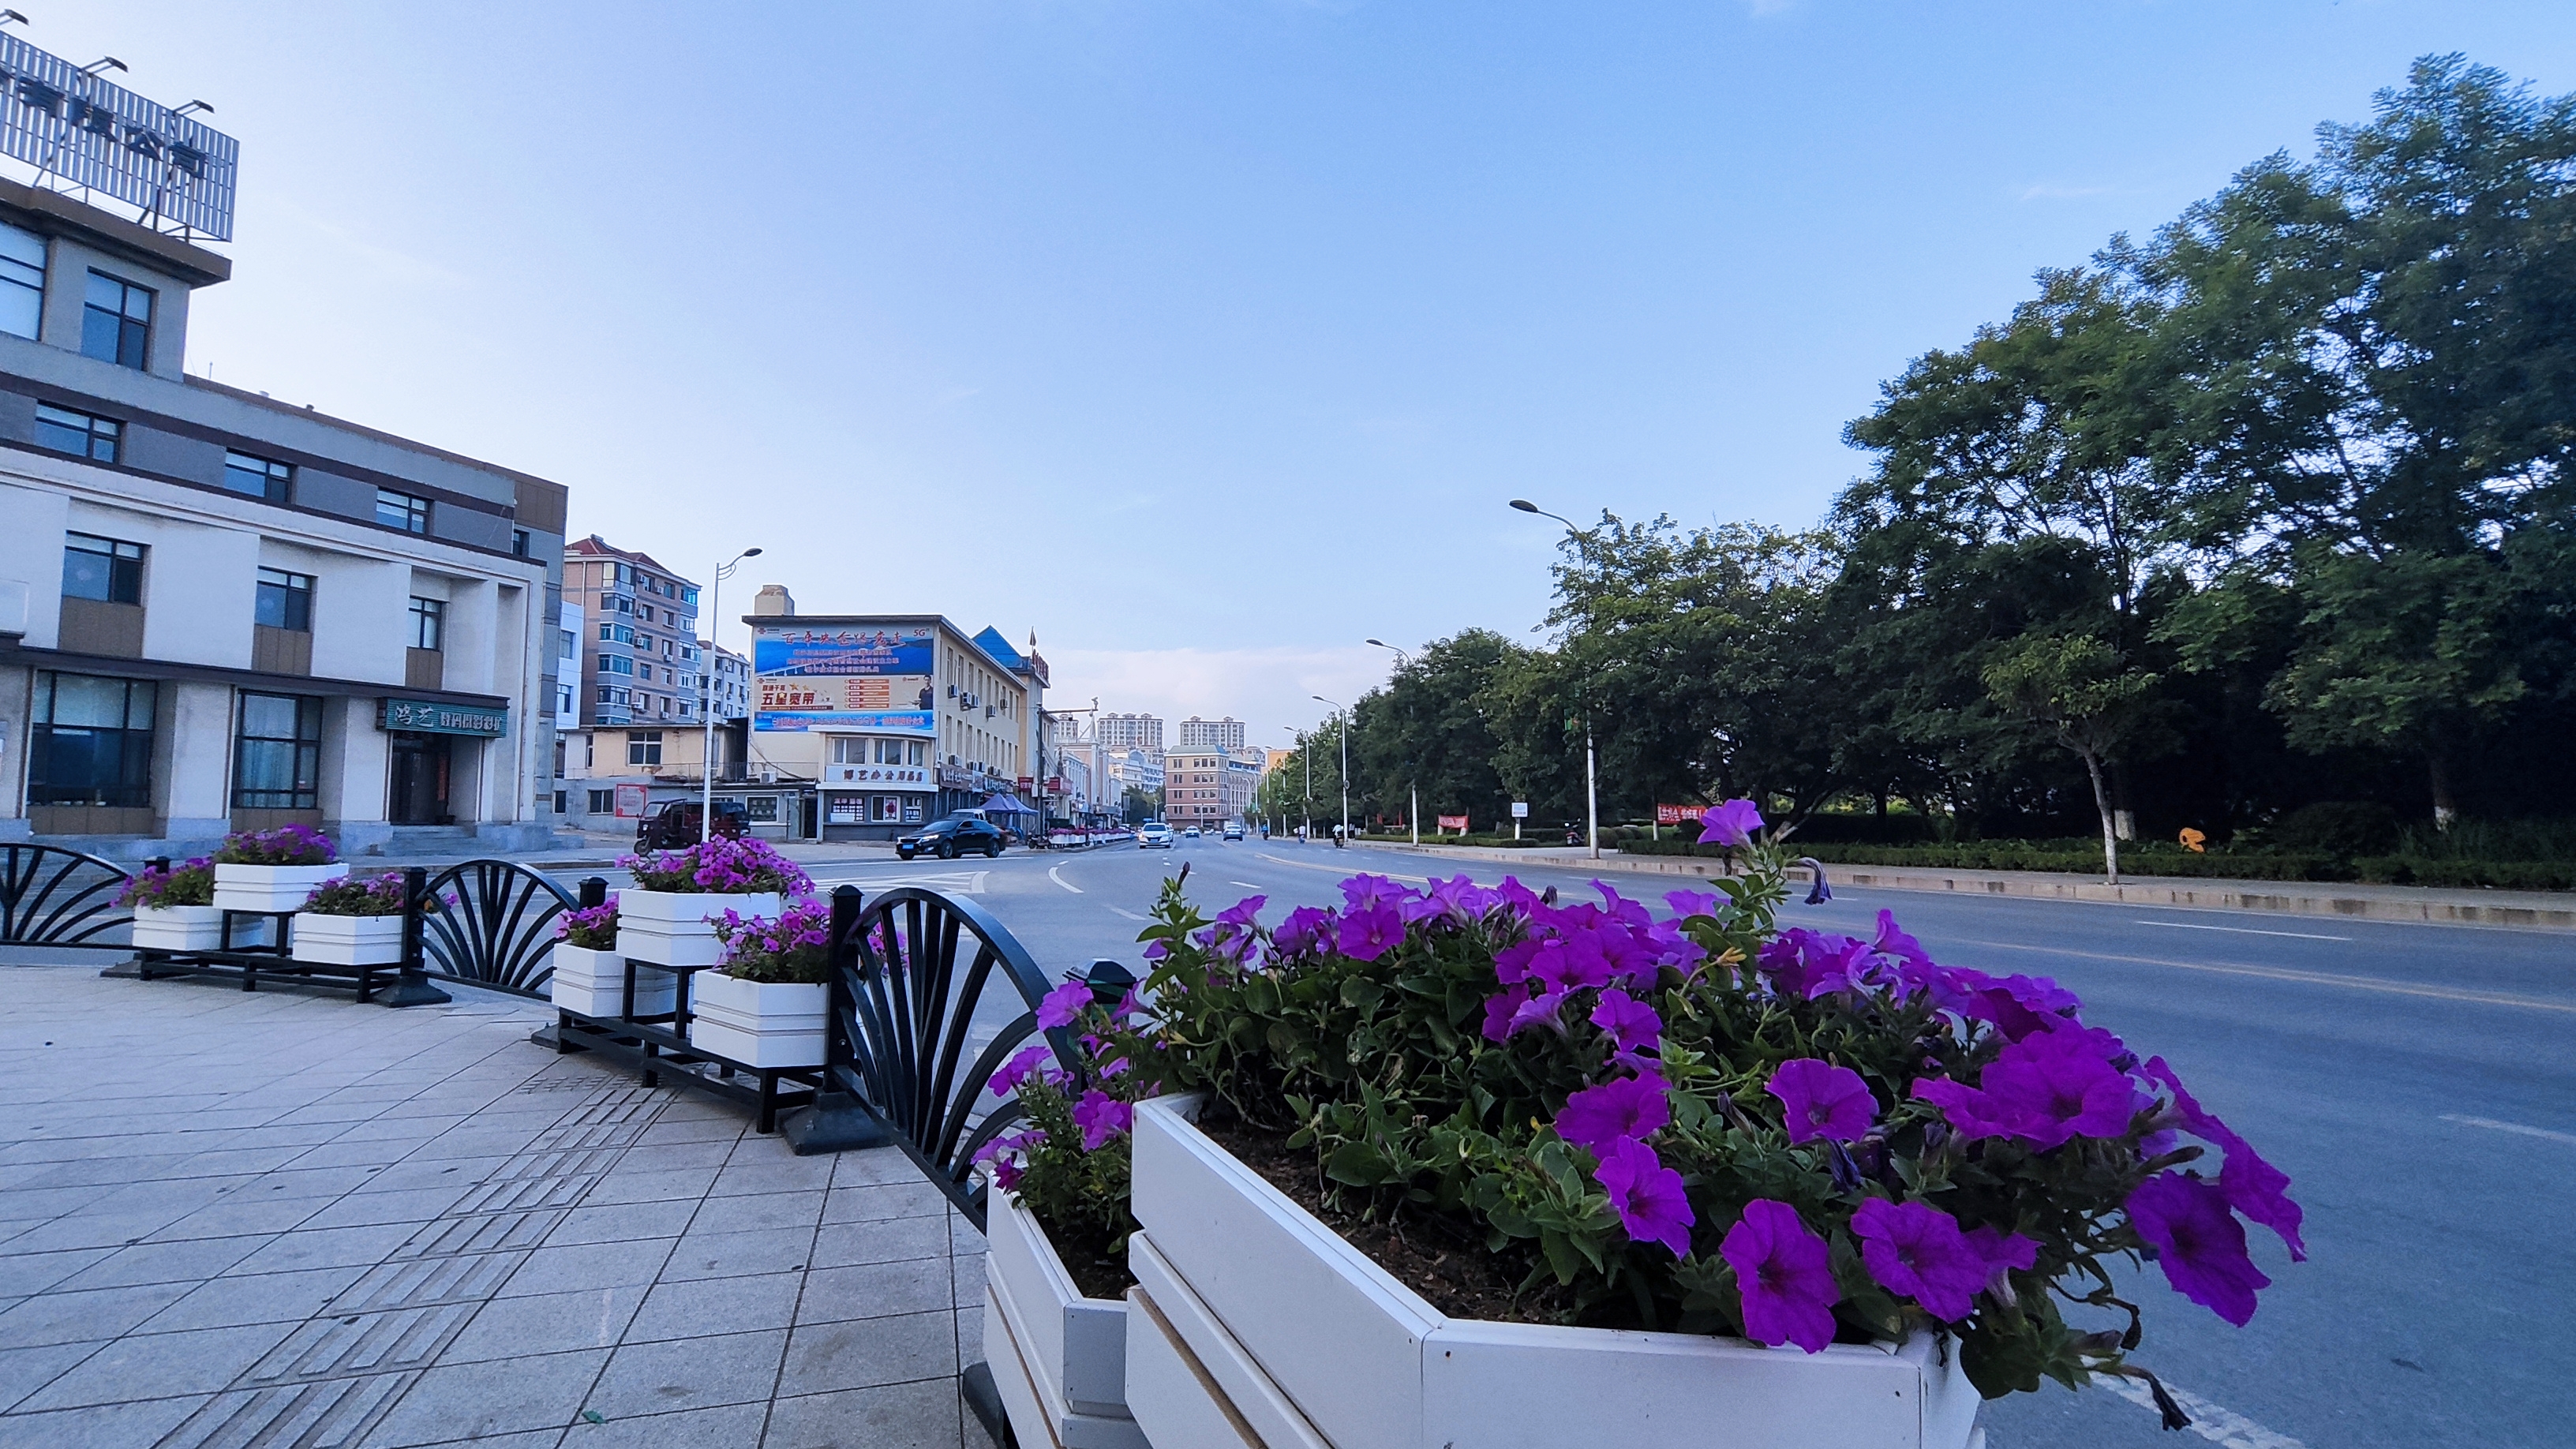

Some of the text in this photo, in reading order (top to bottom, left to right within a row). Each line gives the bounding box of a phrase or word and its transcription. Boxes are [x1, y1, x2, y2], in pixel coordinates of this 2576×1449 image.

[761, 692, 815, 706] 五星宽带
[395, 704, 434, 728] 鸿艺
